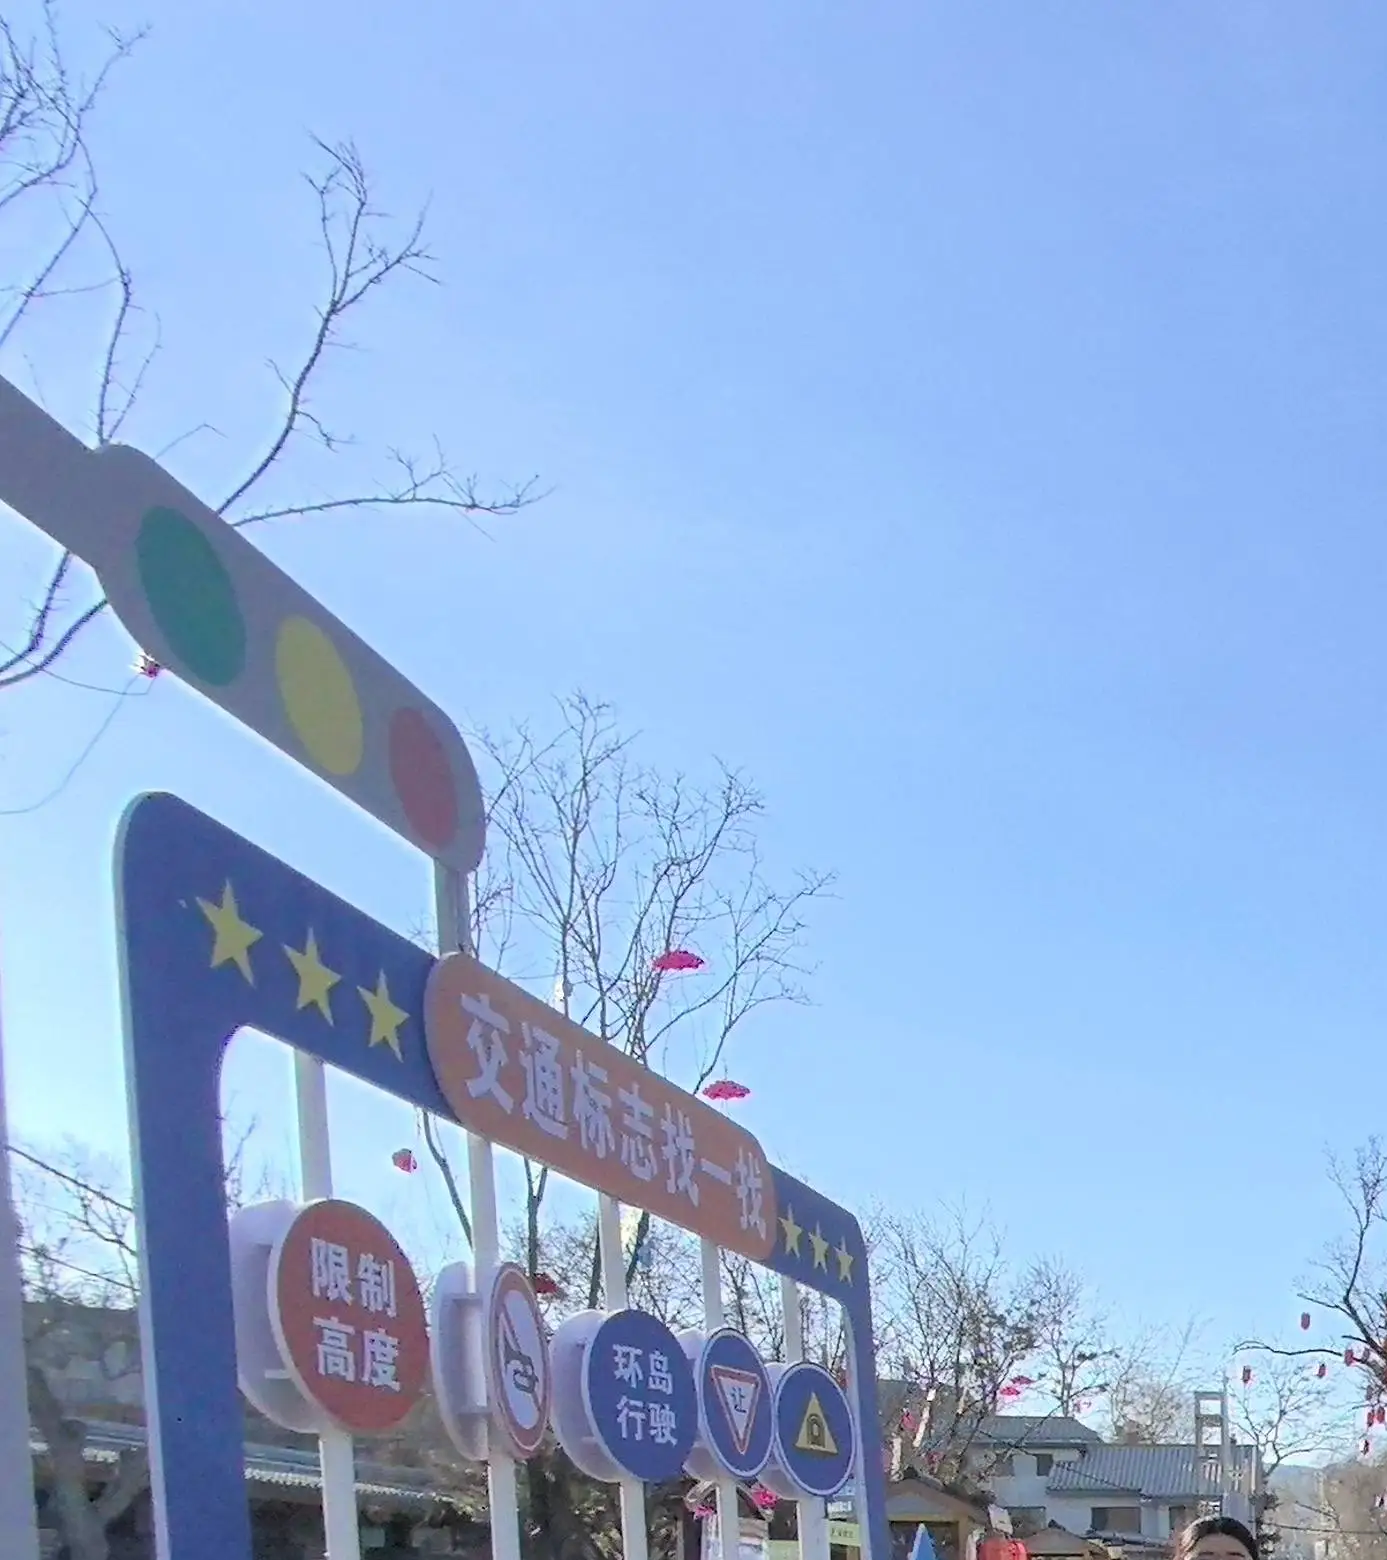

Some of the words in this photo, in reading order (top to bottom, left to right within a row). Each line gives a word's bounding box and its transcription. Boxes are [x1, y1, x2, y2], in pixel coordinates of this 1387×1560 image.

[460, 993, 767, 1241] 交通标志找一找
[310, 1237, 397, 1318] 限制
[312, 1314, 401, 1392] 高度
[612, 1344, 673, 1395] 环岛
[615, 1396, 678, 1447] 行驶
[729, 1386, 747, 1414] 让
